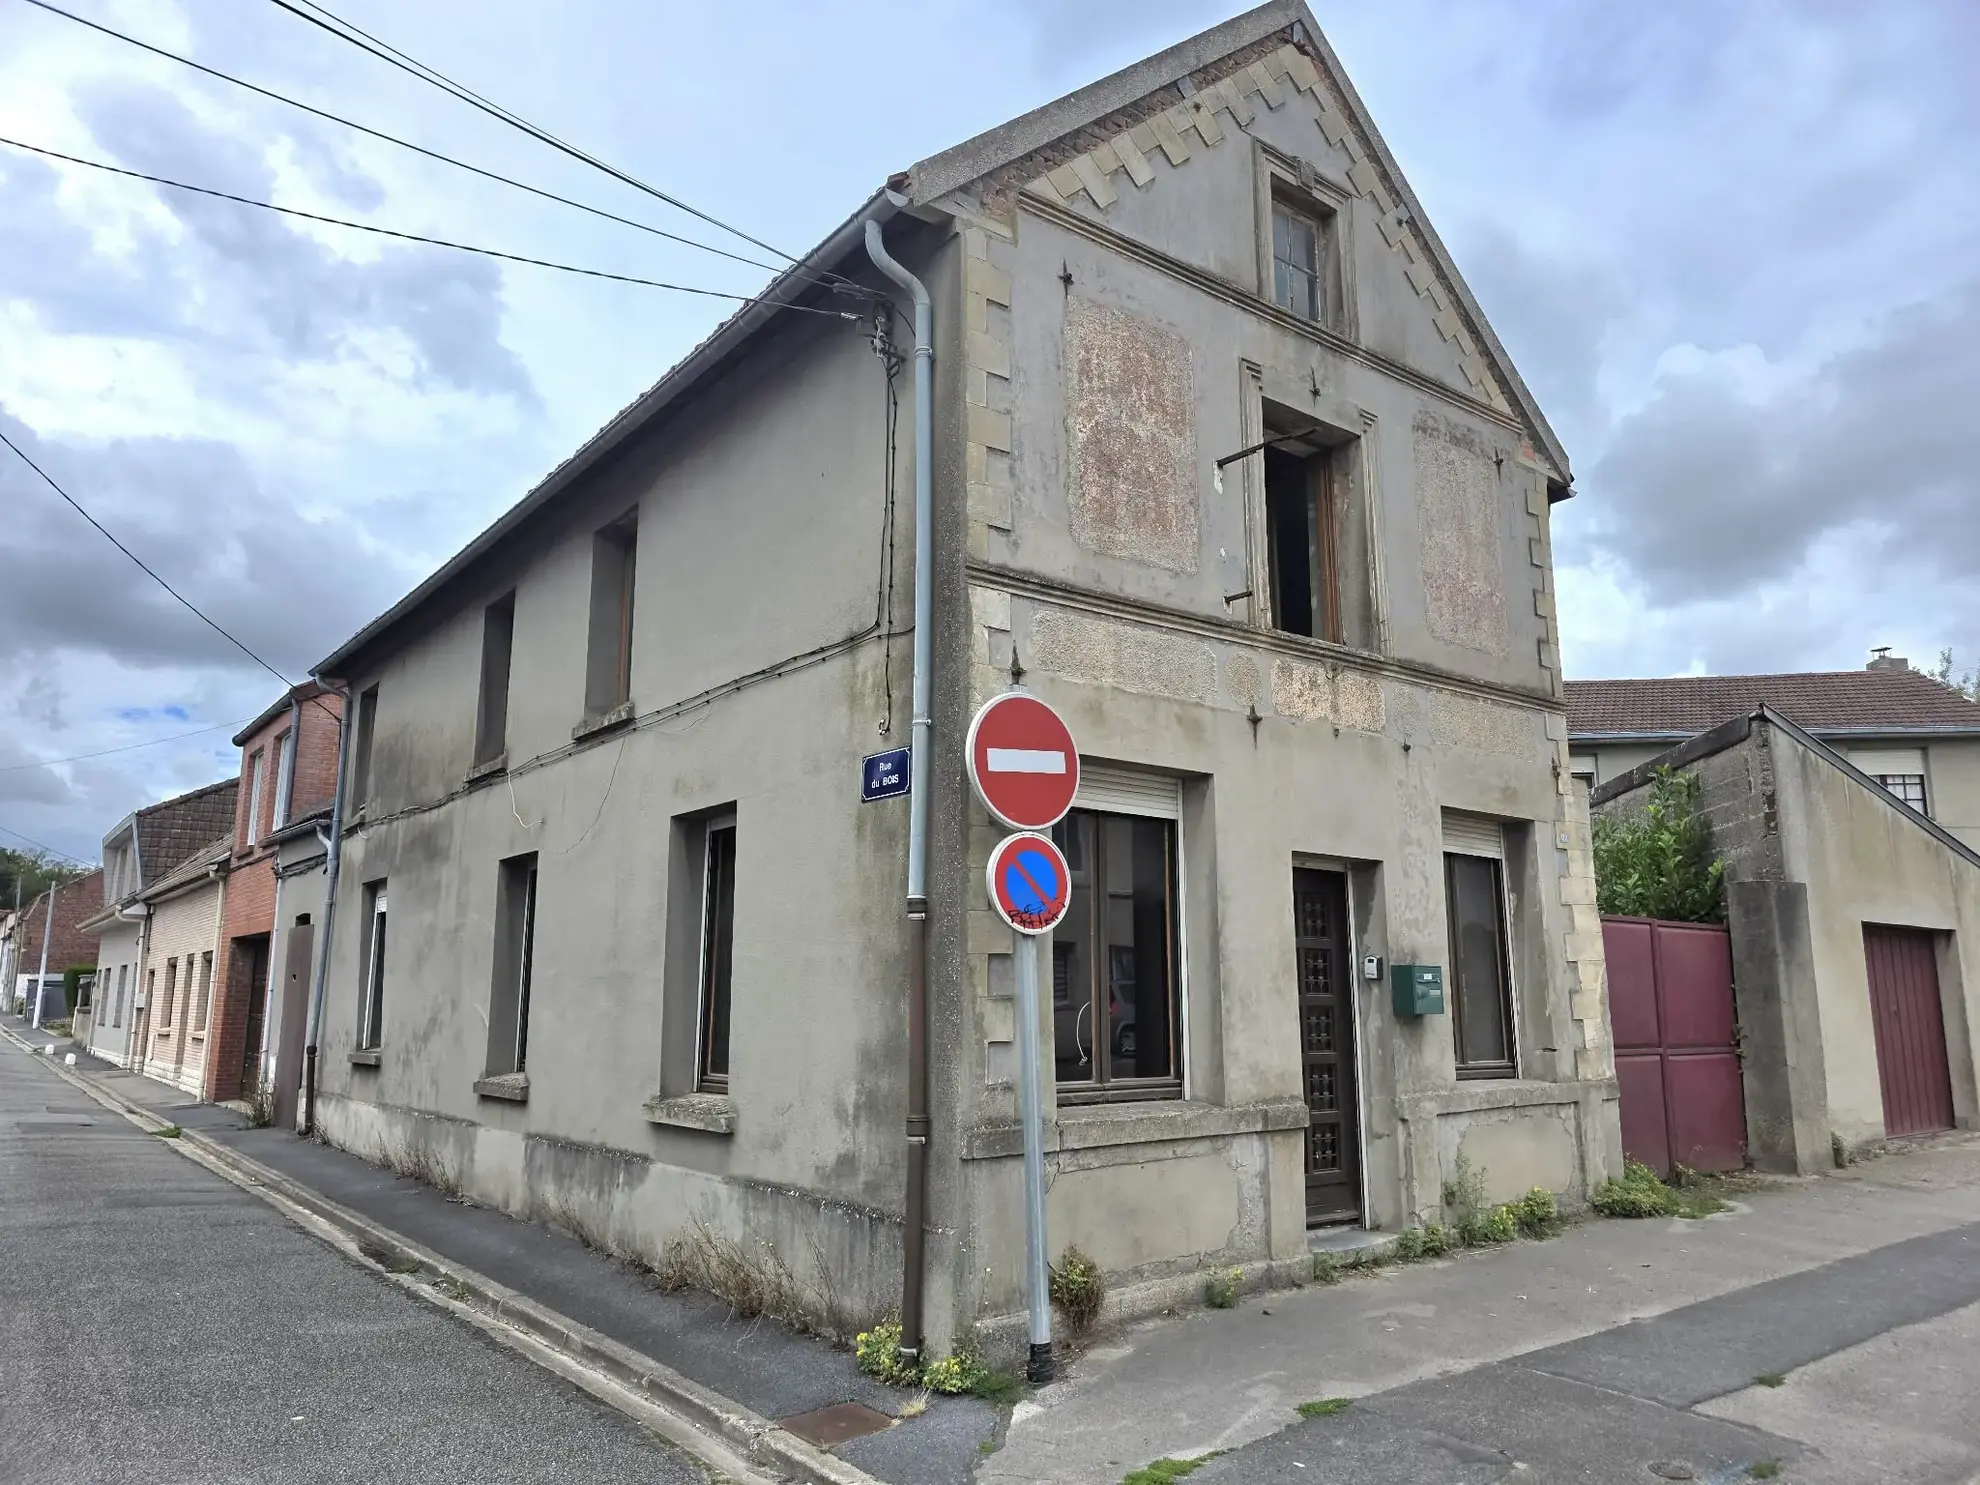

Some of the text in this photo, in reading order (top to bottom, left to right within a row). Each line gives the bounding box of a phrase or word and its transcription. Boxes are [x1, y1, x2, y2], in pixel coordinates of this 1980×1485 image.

[879, 762, 892, 772] Rue
[871, 774, 899, 789] du BOIS
